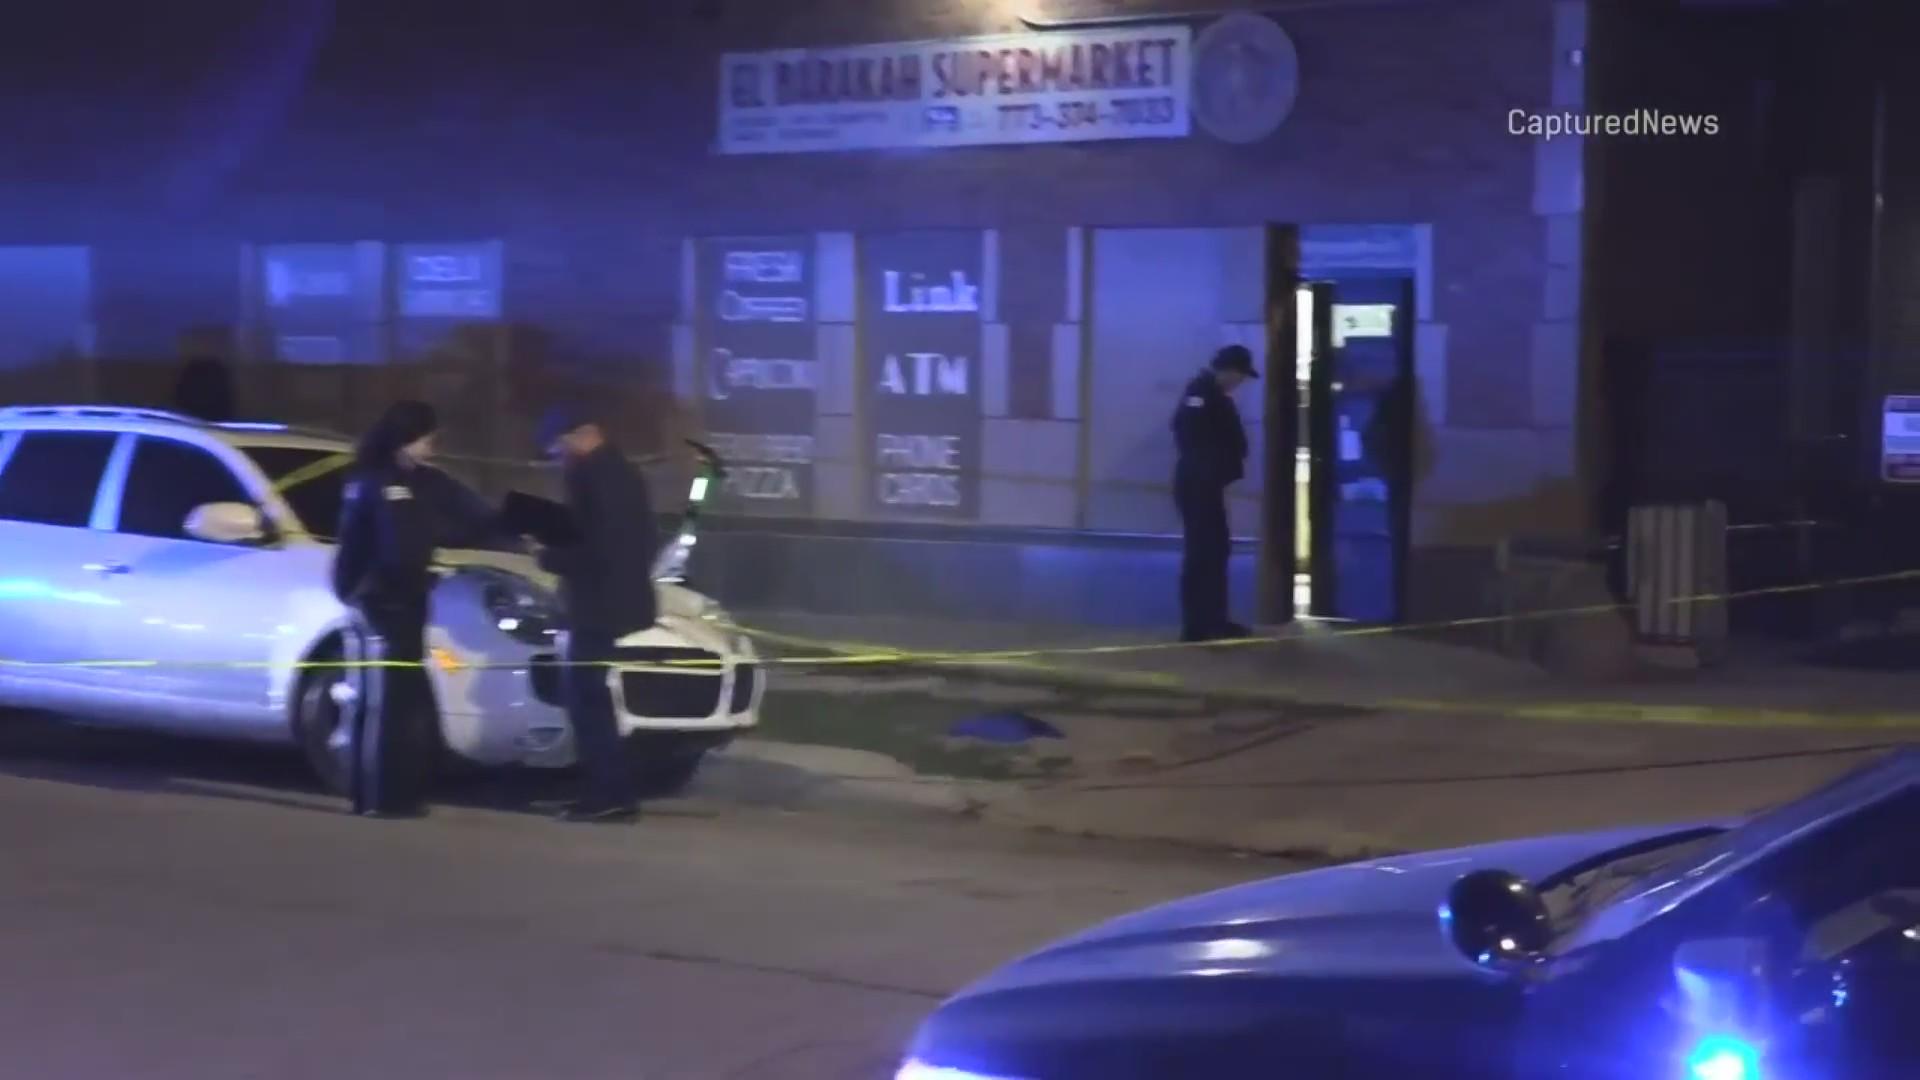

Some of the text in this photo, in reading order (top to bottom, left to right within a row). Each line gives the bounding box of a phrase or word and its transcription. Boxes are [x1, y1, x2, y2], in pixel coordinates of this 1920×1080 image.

[931, 38, 1176, 98] SUPERMARKET
[883, 269, 979, 313] Link
[878, 352, 968, 396] ATM
[877, 432, 961, 470] PHONE
